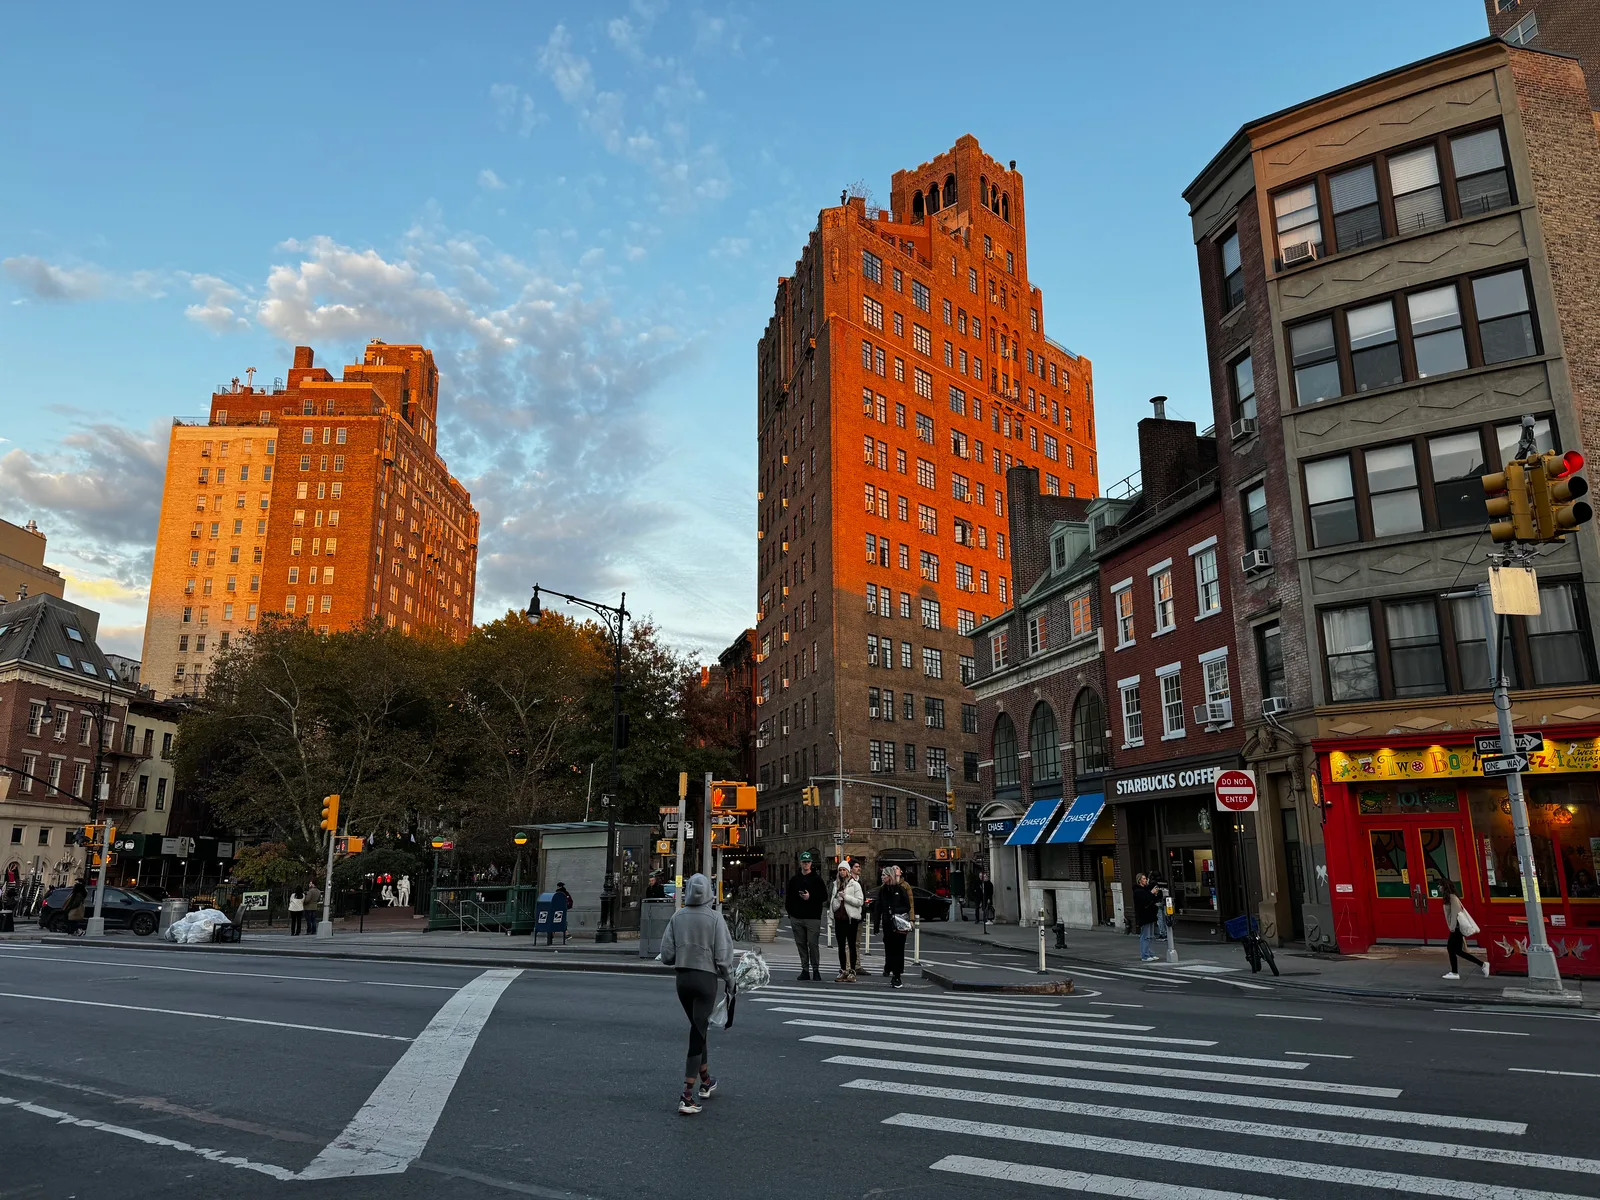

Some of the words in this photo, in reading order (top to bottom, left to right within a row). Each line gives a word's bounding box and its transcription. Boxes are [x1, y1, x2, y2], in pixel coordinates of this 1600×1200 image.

[1481, 740, 1501, 749] ONE
[1576, 748, 1599, 756] WEST
[1429, 750, 1483, 774] BOOT
[1572, 755, 1600, 763] VILLAG
[1486, 762, 1500, 770] ONE
[1506, 759, 1521, 768] WAY
[1116, 773, 1176, 795] STARBUCKS
[1021, 818, 1041, 826] CHASE
[1064, 814, 1087, 823] CHASE
[987, 822, 1004, 832] CHASE
